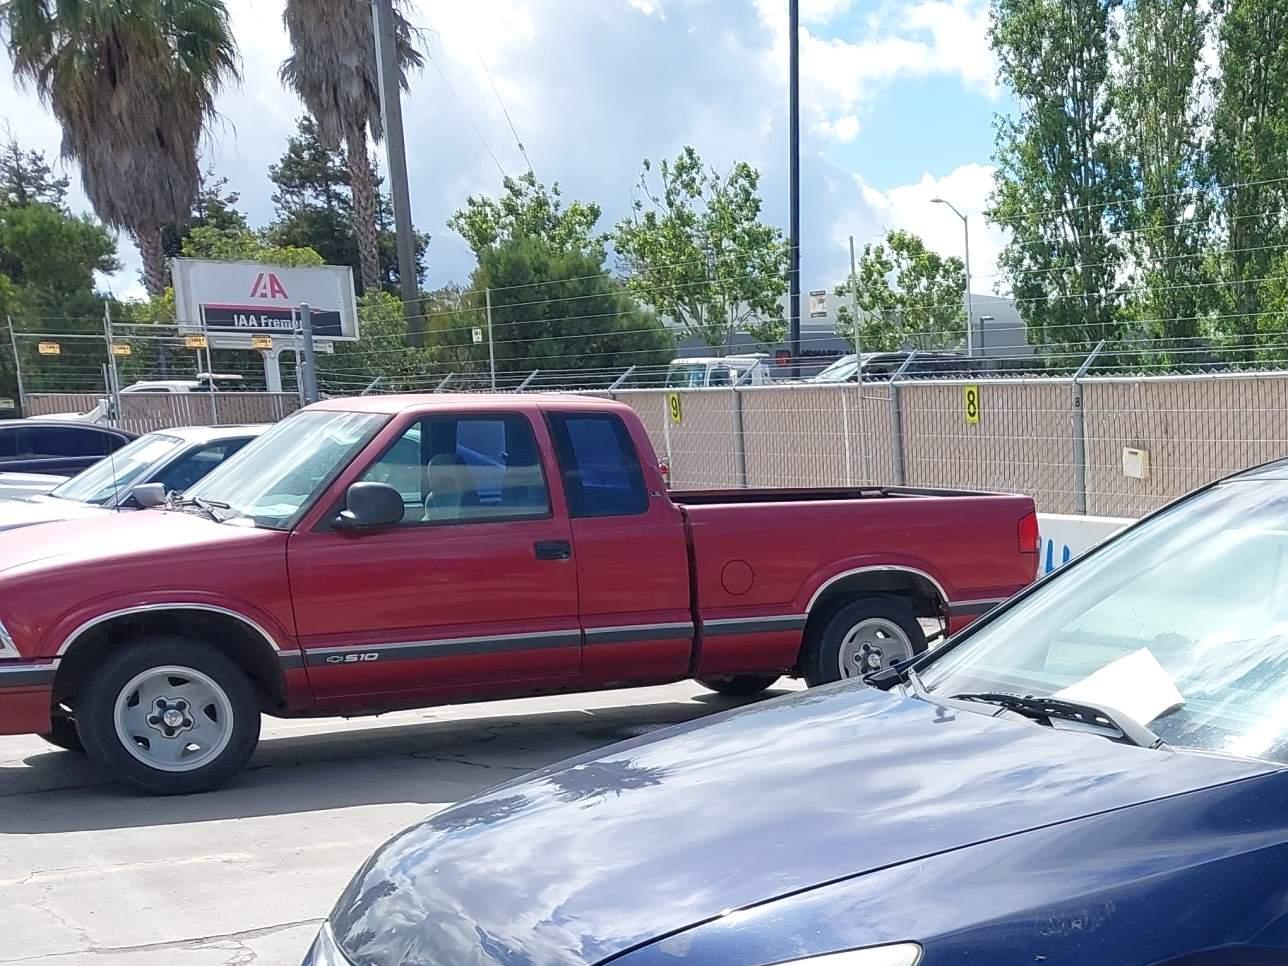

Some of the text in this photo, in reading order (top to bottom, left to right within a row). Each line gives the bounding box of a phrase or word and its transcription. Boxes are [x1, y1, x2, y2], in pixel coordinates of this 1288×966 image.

[233, 313, 257, 328] IAA
[671, 396, 679, 419] 9
[967, 390, 977, 418] 8
[344, 652, 379, 662] S10
